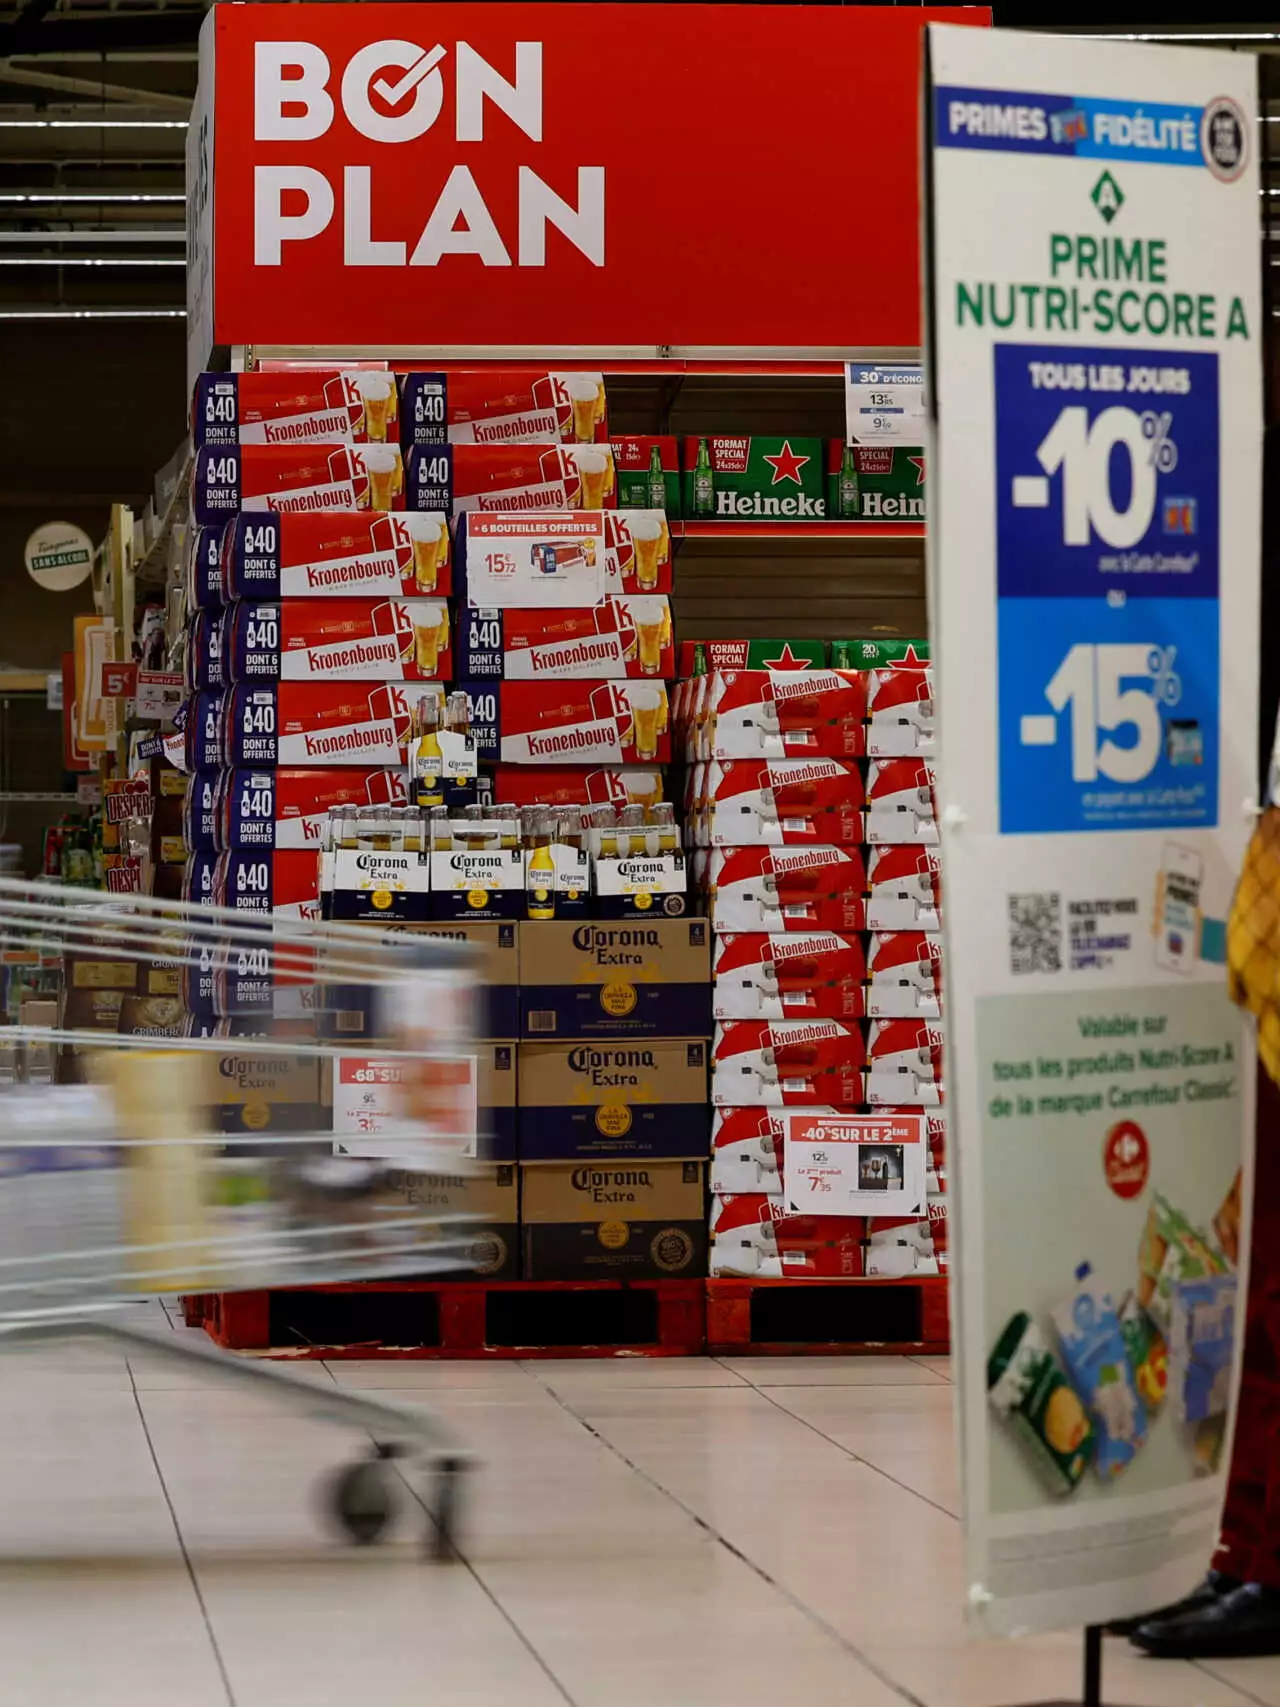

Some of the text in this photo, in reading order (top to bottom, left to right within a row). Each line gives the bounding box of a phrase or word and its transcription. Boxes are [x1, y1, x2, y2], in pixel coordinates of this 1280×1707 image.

[254, 39, 542, 143] BON
[949, 101, 1047, 140] PRIMES
[1093, 109, 1196, 152] FIDÉLITÉ
[254, 165, 605, 267] PLAN
[1050, 233, 1168, 284] PRIME
[955, 281, 1249, 340] NUTRI-SCORE A
[1029, 363, 1191, 394] TOUS LES JOURS
[215, 396, 235, 422] 40
[424, 396, 444, 422] 40
[206, 428, 236, 437] DONT 6
[264, 414, 347, 444] Kronenbourg
[415, 427, 444, 437] DONT 6
[472, 414, 556, 444] Kronenbourg
[713, 440, 747, 449] FORMAT
[715, 449, 745, 458] SPECIAL
[859, 451, 889, 460] SPECIAL
[216, 457, 237, 484] 40
[428, 457, 448, 484] 40
[1012, 405, 1179, 549] -10%
[206, 489, 237, 499] DONT 6
[206, 500, 237, 508] OFFERTES
[266, 487, 352, 511] Kronenbourg
[418, 489, 449, 499] DONT 6
[418, 500, 449, 508] OFFERTES
[478, 488, 563, 511] Kronenbourg
[716, 492, 826, 516] Heineke
[255, 526, 275, 553] 40
[481, 523, 597, 533] 6 BOUTEILLES OFFERTES
[244, 559, 276, 570] DONT 6
[244, 570, 277, 579] OFFERTES
[306, 557, 395, 588] Kronenbourg
[256, 621, 277, 649] 40
[479, 621, 500, 648] 40
[246, 654, 278, 665] DONT 6
[308, 642, 397, 672] Kronenbourg
[469, 654, 501, 665] DONT 6
[530, 639, 619, 671] Kronenbourg
[710, 644, 745, 654] FORMAT
[712, 655, 744, 664] SPECIAL
[862, 644, 876, 654] 20
[246, 665, 278, 674] OFFERTES
[469, 665, 501, 674] OFFERTES
[772, 675, 840, 699] Kronenbourg
[253, 706, 274, 733] 40
[475, 694, 496, 722] 40
[1020, 643, 1182, 784] -15%
[243, 739, 275, 750] DONT 6
[304, 726, 394, 757] Kronenbourg
[526, 725, 615, 756] Kronenbourg
[243, 750, 275, 759] OFFERTES
[770, 763, 837, 786] Kronenbourg
[250, 790, 272, 817] 40
[240, 823, 272, 834] DONT 6
[240, 834, 272, 844] OFFERTES
[356, 853, 409, 871] Corona
[450, 853, 503, 872] Corona
[618, 861, 664, 877] Corona
[773, 849, 839, 871] Kronenbourg
[247, 863, 268, 891] 40
[370, 869, 398, 879] Extra
[465, 869, 492, 878] Extra
[631, 874, 655, 883] Extra
[237, 896, 268, 907] DONT 6
[573, 925, 659, 953] Corona
[772, 936, 839, 959] Kronenbourg
[597, 949, 643, 965] Extra
[772, 1023, 838, 1046] Kronenbourg
[1078, 1014, 1167, 1039] Valable sur
[219, 1056, 290, 1079] Corona
[568, 1046, 654, 1074] Corona
[992, 1058, 1033, 1081] tous
[1036, 1056, 1064, 1078] les
[1066, 1051, 1135, 1079] produits
[592, 1070, 638, 1086] Extra
[988, 1083, 1181, 1118] de la marque Carrefour
[831, 1128, 859, 1140] SUR
[864, 1128, 879, 1141] LE
[571, 1167, 652, 1192] Corona
[593, 1188, 635, 1203] Extra
